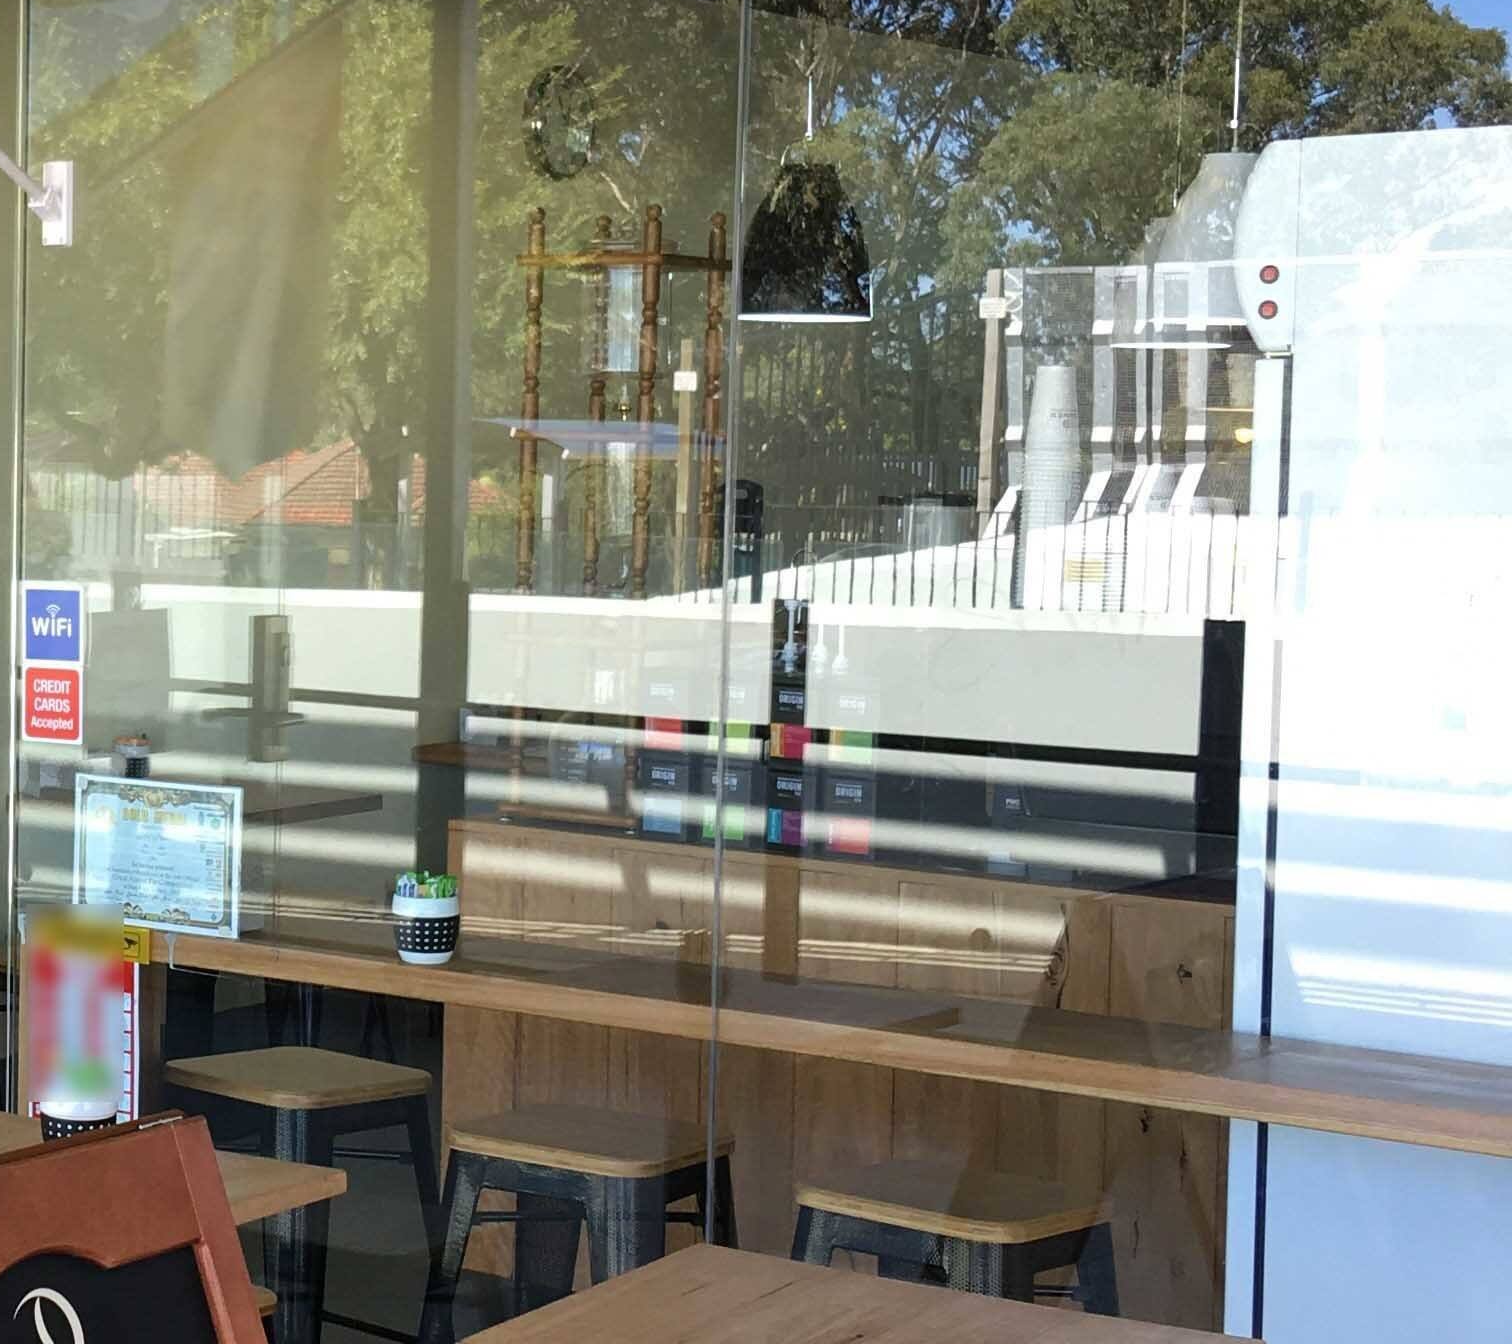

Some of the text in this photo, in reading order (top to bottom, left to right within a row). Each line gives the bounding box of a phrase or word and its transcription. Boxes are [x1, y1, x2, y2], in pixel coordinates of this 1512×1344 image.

[31, 616, 72, 638] WiFi
[33, 678, 71, 694] CREDIT
[34, 697, 70, 713] CARDS
[31, 716, 74, 731] Accepted
